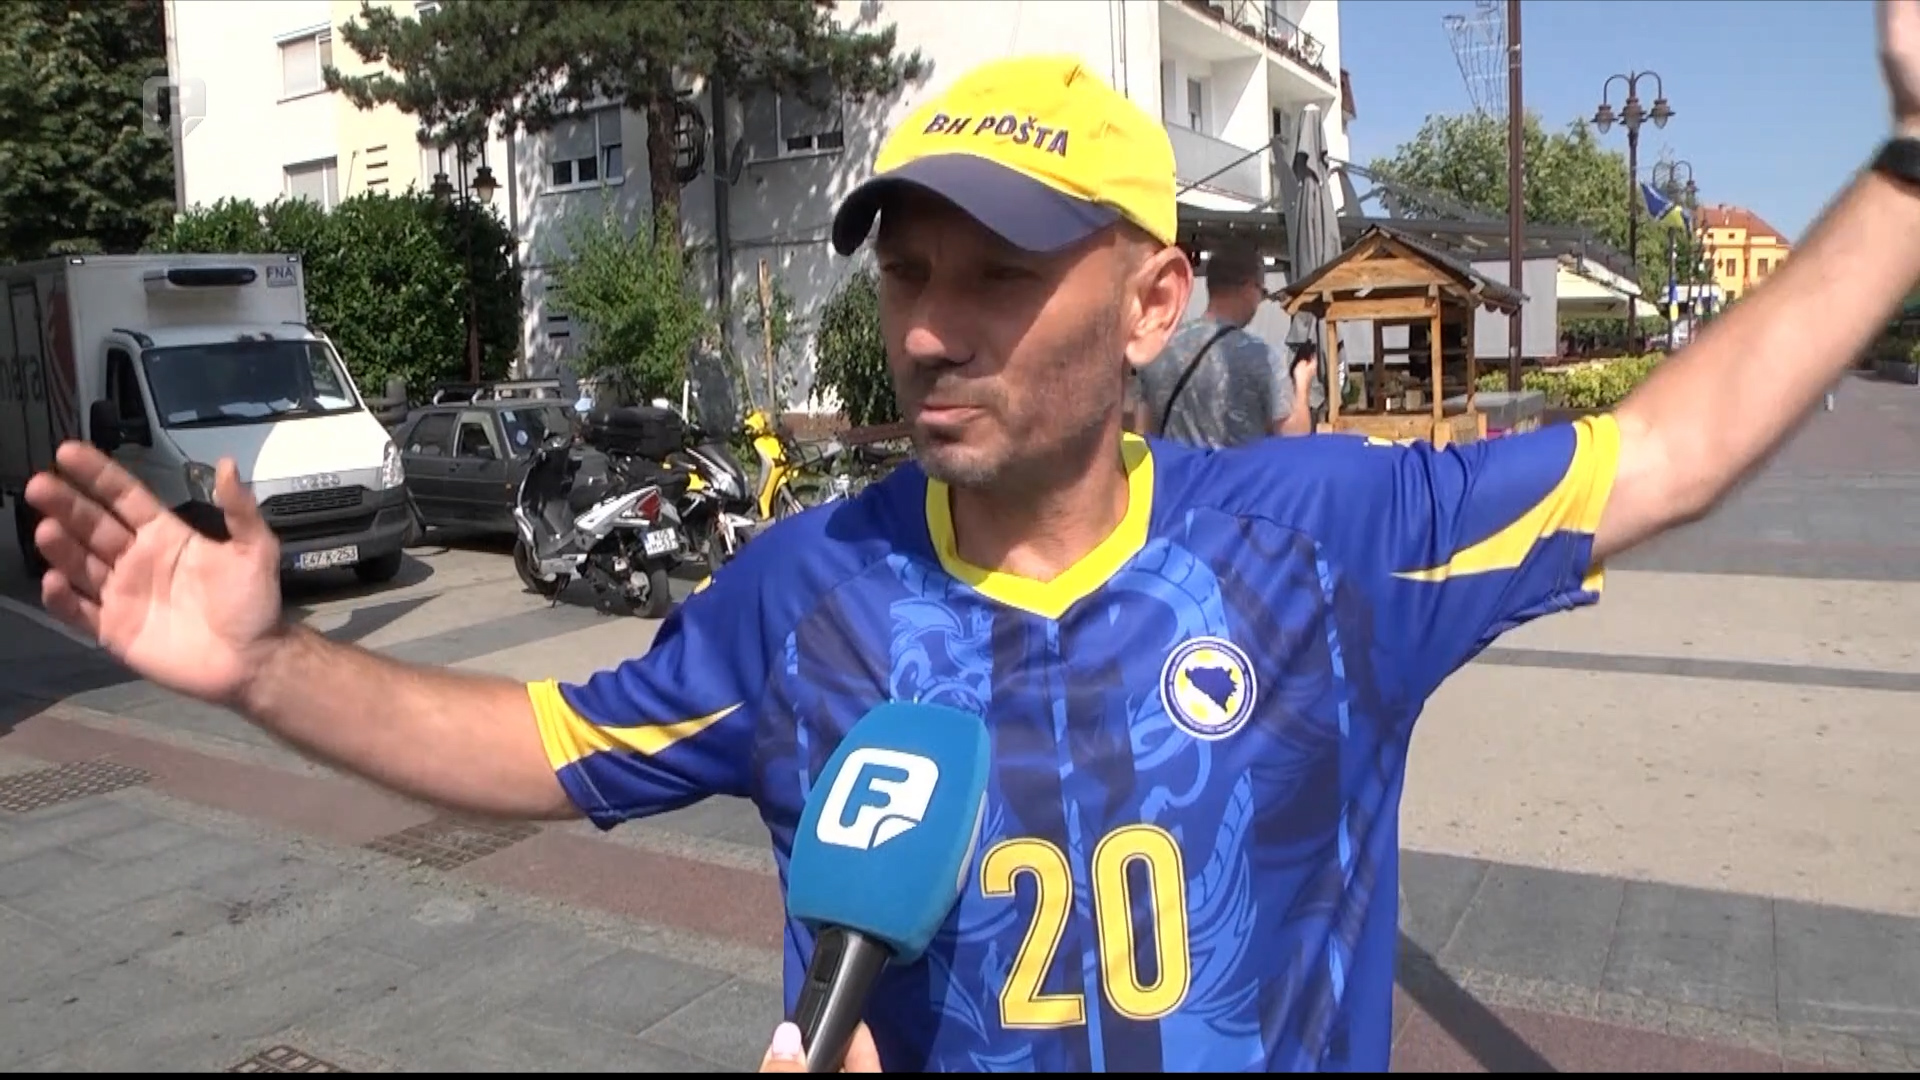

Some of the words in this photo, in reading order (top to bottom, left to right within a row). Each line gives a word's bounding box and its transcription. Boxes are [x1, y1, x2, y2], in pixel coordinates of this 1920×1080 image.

[923, 113, 972, 135] BH
[973, 115, 1069, 158] POŠTA
[838, 762, 910, 828] F
[979, 823, 1192, 1030] 20
